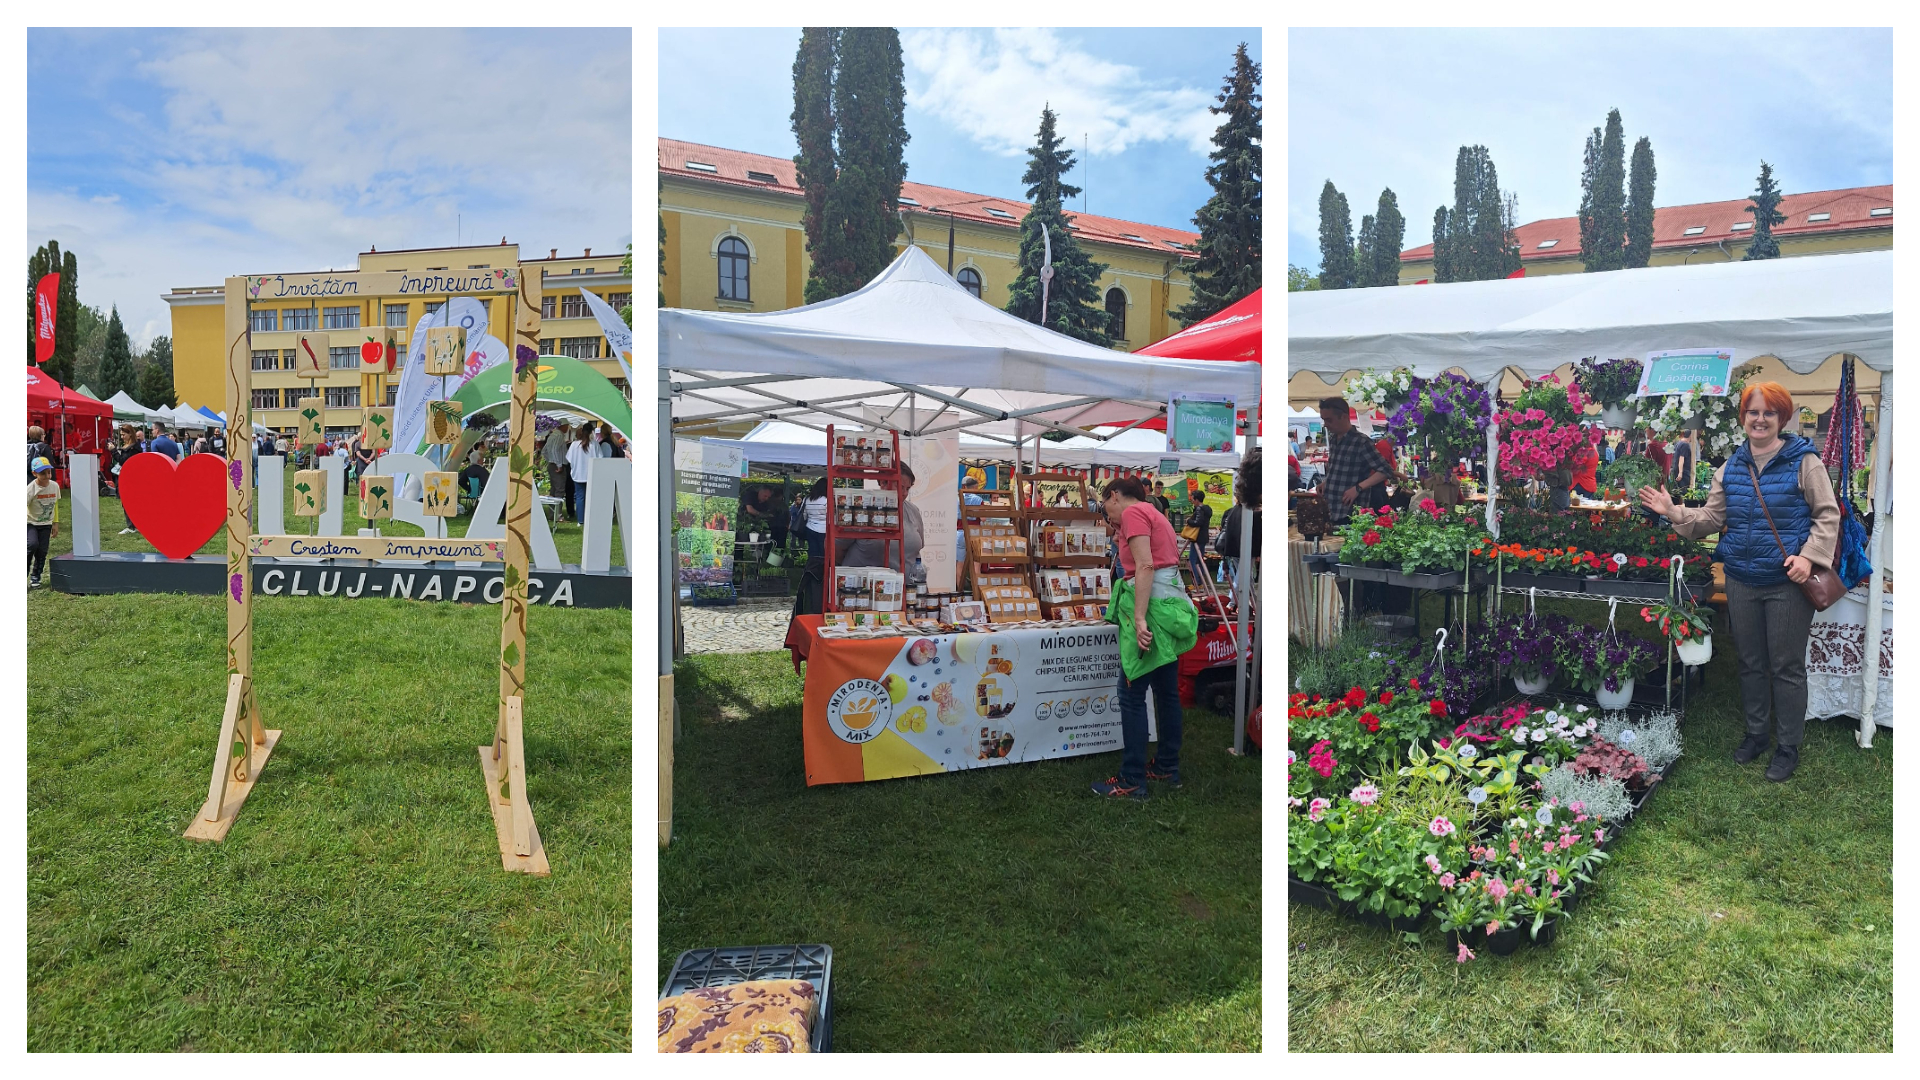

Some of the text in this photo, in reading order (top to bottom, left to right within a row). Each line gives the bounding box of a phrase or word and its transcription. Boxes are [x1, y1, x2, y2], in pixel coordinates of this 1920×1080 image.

[1670, 361, 1709, 371] Corina
[1181, 412, 1228, 427] Mirodenya
[1196, 428, 1213, 440] Mix
[385, 542, 485, 559] împreună
[261, 569, 575, 606] CLUJ-NAPOCA
[1040, 633, 1118, 650] MIRODENYA
[1041, 657, 1055, 666] MIX
[1055, 657, 1065, 665] DE
[1066, 654, 1093, 665] LEGUME
[1035, 667, 1066, 676] CHIPSURI
[1067, 665, 1076, 674] DE
[1077, 663, 1102, 673] FRUCTE
[1063, 671, 1119, 683] CEAIURI NATURAL
[831, 680, 888, 708] MIRODENYA
[845, 729, 873, 741] MIX
